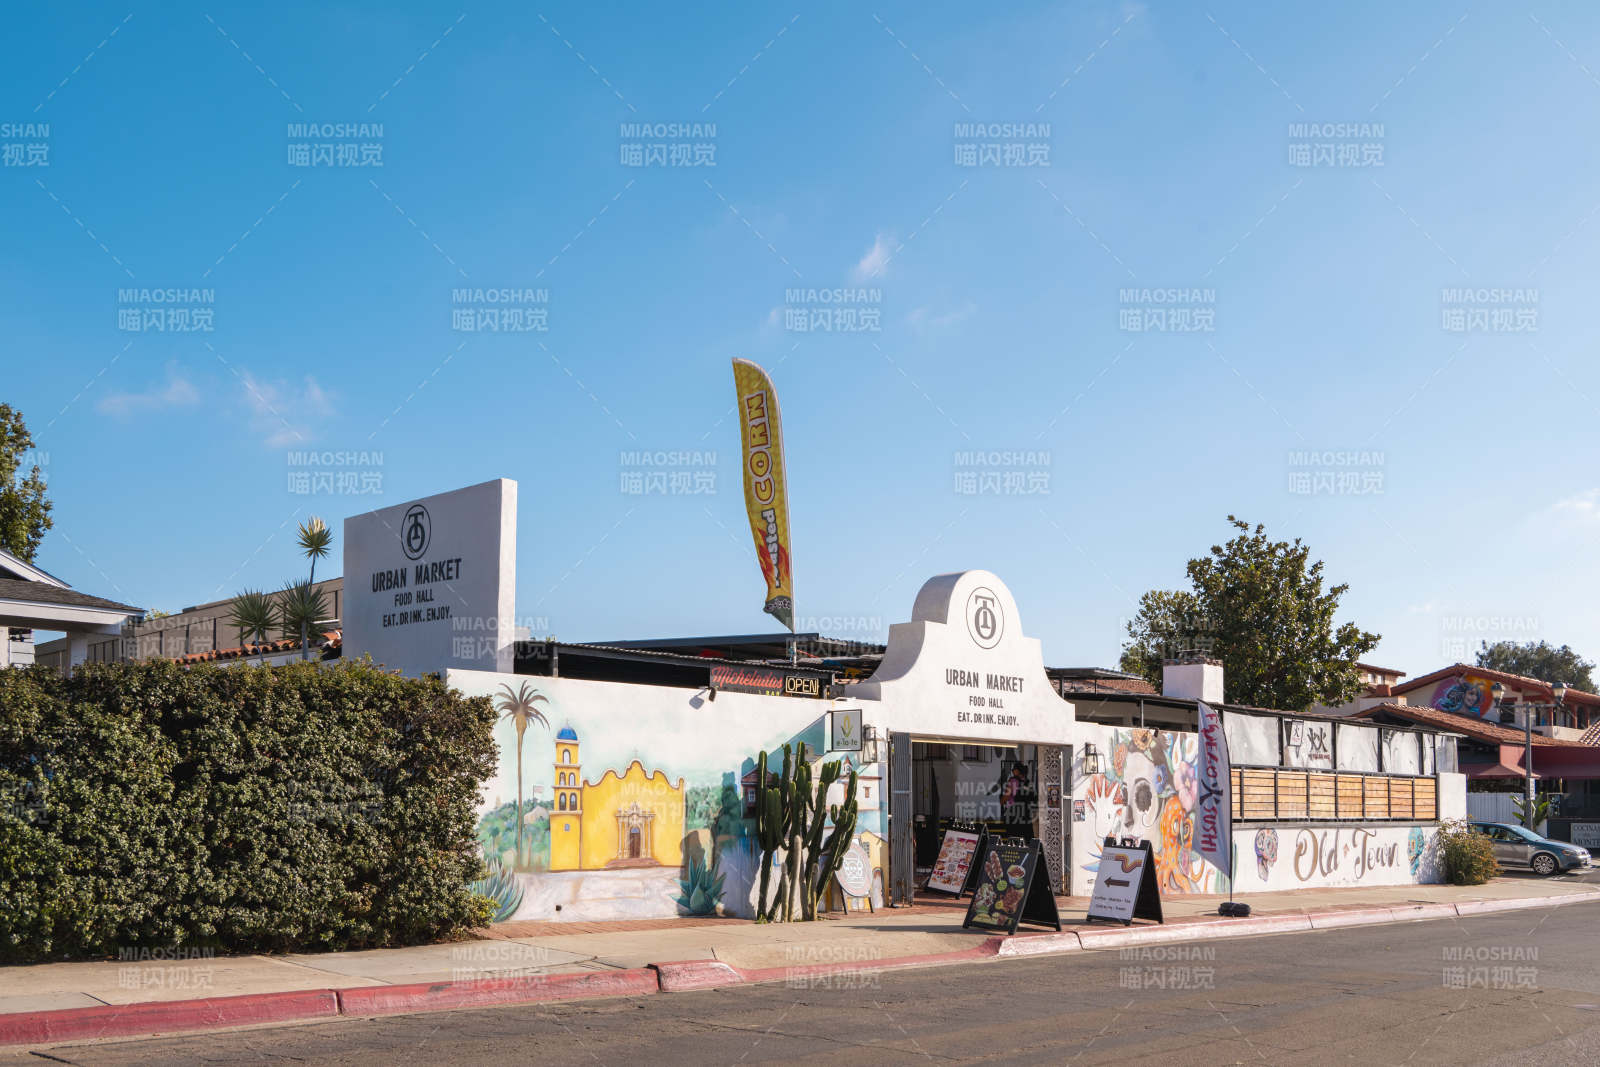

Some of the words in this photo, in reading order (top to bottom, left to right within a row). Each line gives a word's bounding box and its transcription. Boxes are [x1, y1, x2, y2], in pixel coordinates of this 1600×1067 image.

[744, 391, 775, 505] CORN
[372, 567, 407, 593] URBAN
[415, 558, 462, 585] MARKET
[394, 591, 413, 608] FOOD
[416, 589, 434, 604] HALL
[787, 677, 818, 694] OPEN
[945, 668, 979, 689] URBAN
[986, 674, 1024, 693] MARKET
[969, 695, 985, 707] FOOD
[988, 697, 1004, 709] HALL
[1200, 806, 1219, 853] SUSHI
[1294, 828, 1340, 881] Old
[1352, 828, 1401, 880] Town
